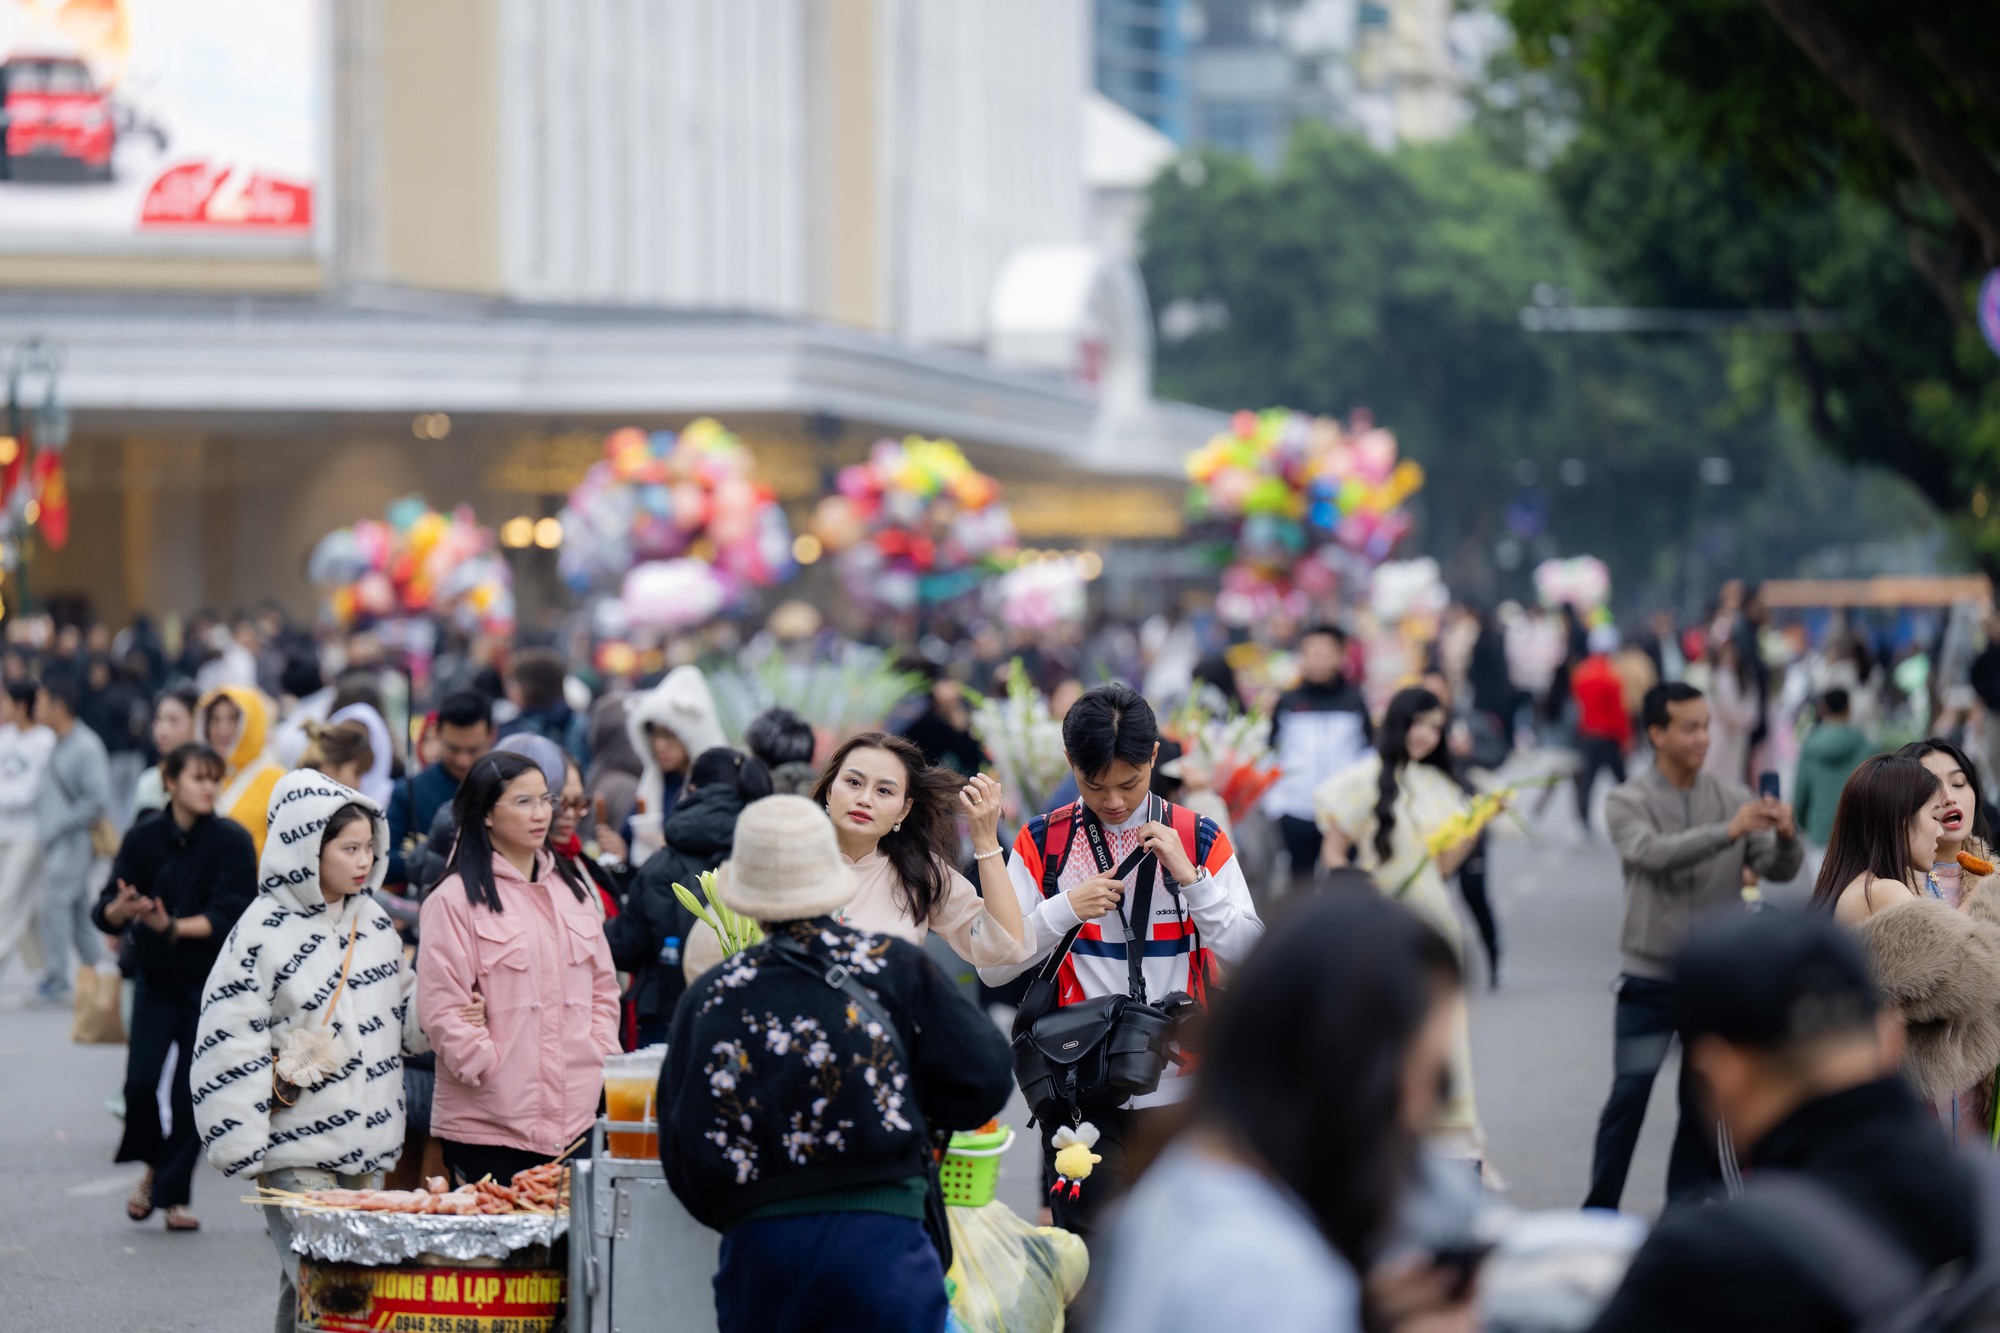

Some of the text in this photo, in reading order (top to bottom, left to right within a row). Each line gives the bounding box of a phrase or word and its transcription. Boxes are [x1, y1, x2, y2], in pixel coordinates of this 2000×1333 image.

[1089, 824, 1110, 871] EOS DIGIT
[431, 1272, 459, 1303] ĐÁ
[463, 1277, 500, 1310] LẠP
[430, 1317, 452, 1332] 285
